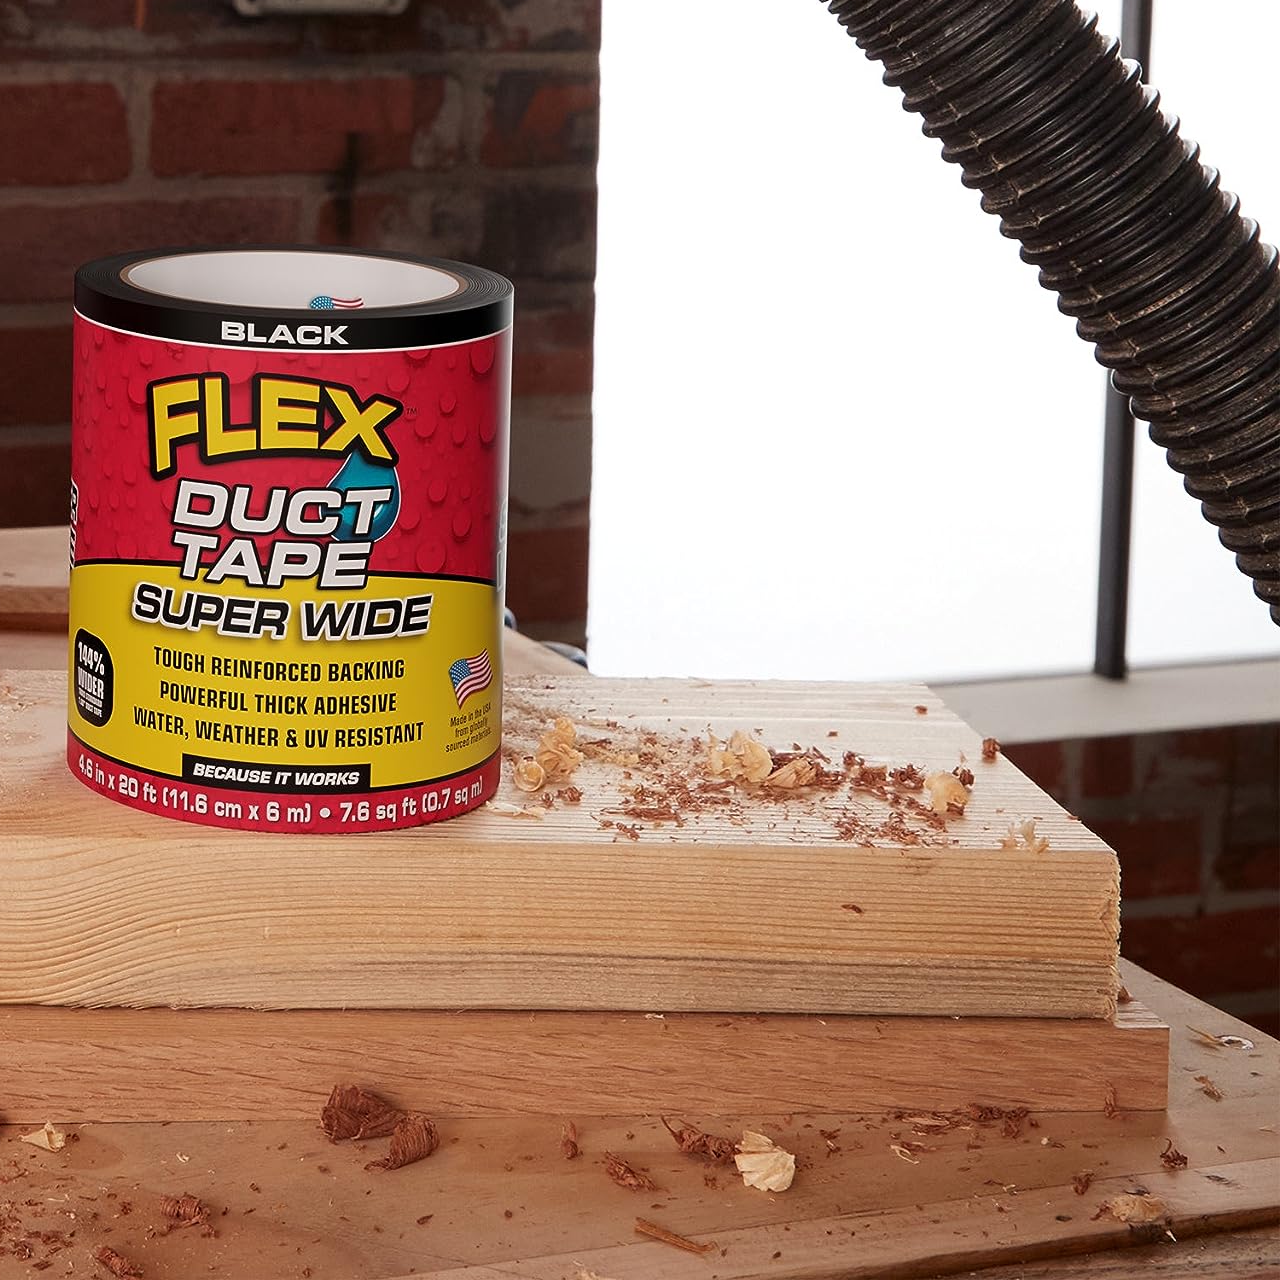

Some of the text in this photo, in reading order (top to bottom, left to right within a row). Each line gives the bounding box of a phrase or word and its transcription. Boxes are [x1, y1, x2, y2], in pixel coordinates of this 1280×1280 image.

[221, 321, 349, 345] BLACK
[150, 374, 401, 477] FLEX
[173, 479, 392, 536] DUCT
[173, 531, 372, 588] TAPE
[132, 582, 434, 640] SUPER WIDE
[78, 641, 105, 675] 144%
[153, 646, 405, 682] TOUGH REINFORCED BACKING
[77, 666, 104, 700] WIDER
[160, 680, 397, 715] POWERFUL THICK ADHESIVE
[133, 705, 189, 741] WATER,
[195, 719, 279, 747] WEATHER
[285, 728, 298, 748] &
[304, 729, 329, 749] UV
[335, 721, 424, 748] RESISTANT
[450, 715, 467, 727] Made
[468, 711, 474, 721] in
[445, 735, 470, 753] sourced
[78, 754, 484, 824] 4.6 in x 20 ft (11.6 cm x 6 m) 7.6 sq ft (0.7 sq m)
[193, 763, 360, 786] BECAUSE IT WORKS
